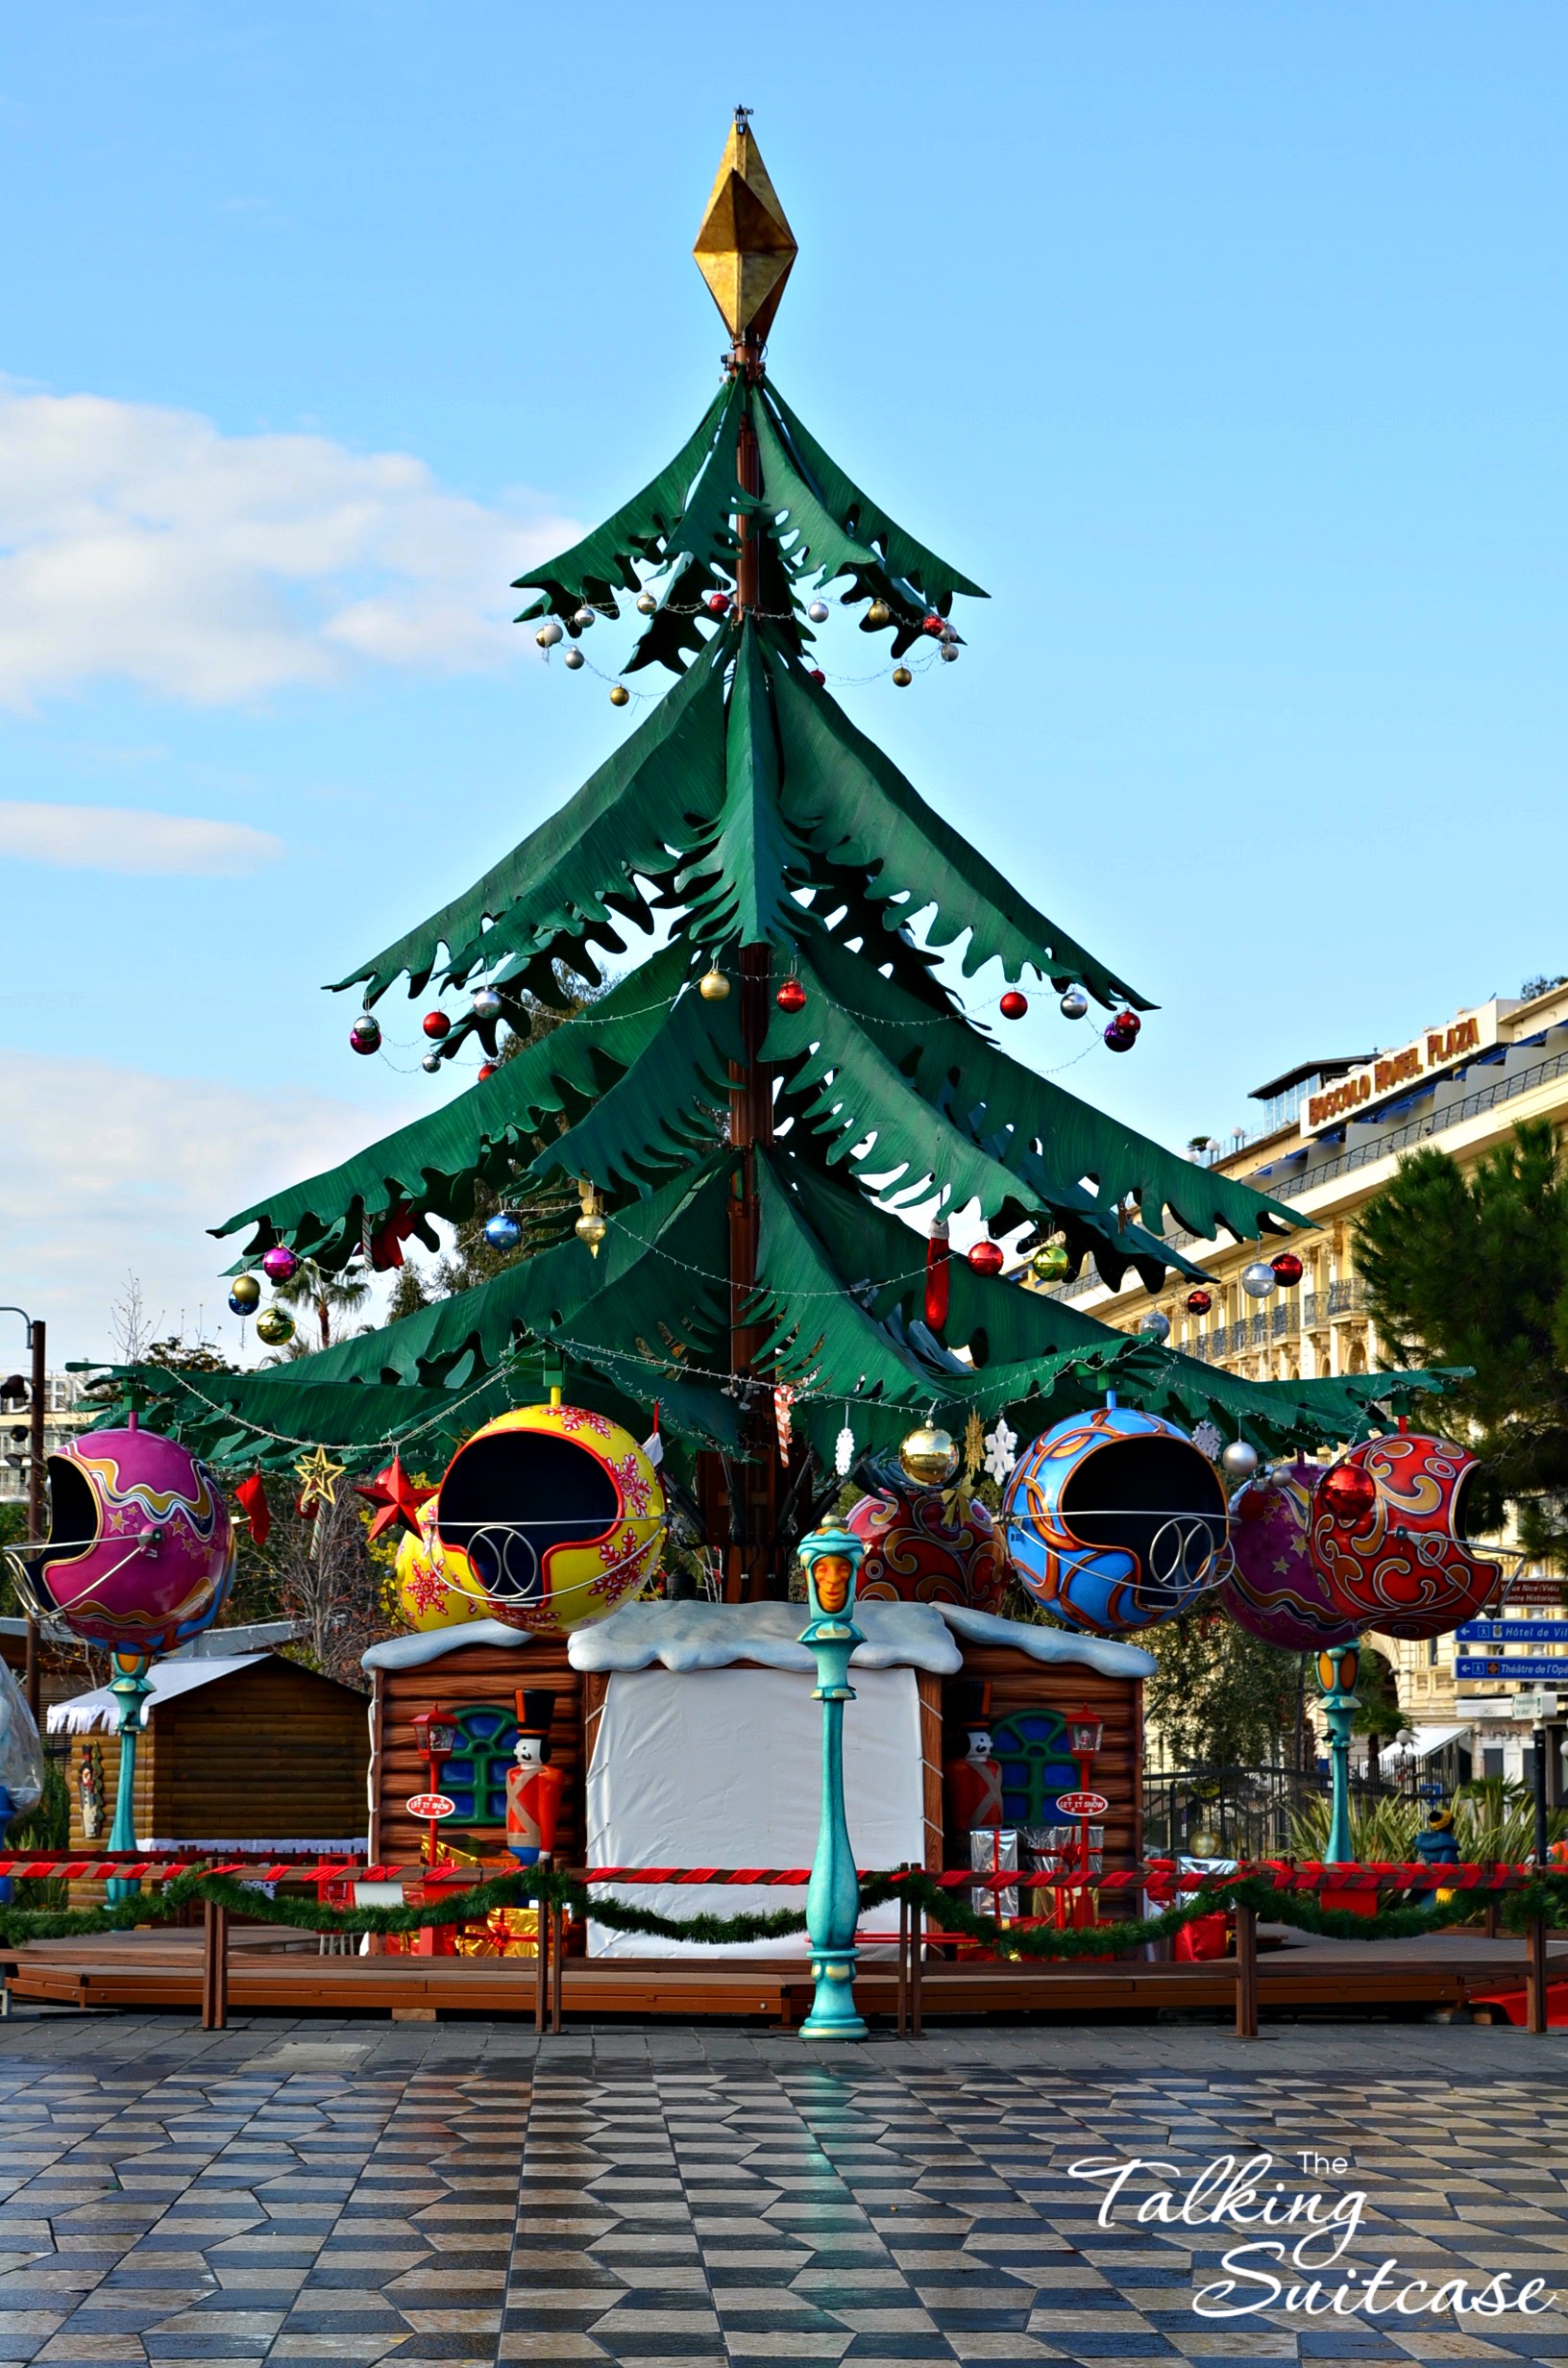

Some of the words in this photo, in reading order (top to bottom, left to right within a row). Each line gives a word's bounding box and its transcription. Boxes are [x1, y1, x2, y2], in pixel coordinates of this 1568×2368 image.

[1374, 1048, 1423, 1093] HOTEL
[1427, 1018, 1480, 1066] PLAZA
[1506, 1627, 1533, 1637] Hôtel
[1537, 1627, 1549, 1637] de
[1501, 1664, 1533, 1674] Théâtre
[1534, 1664, 1546, 1674] de
